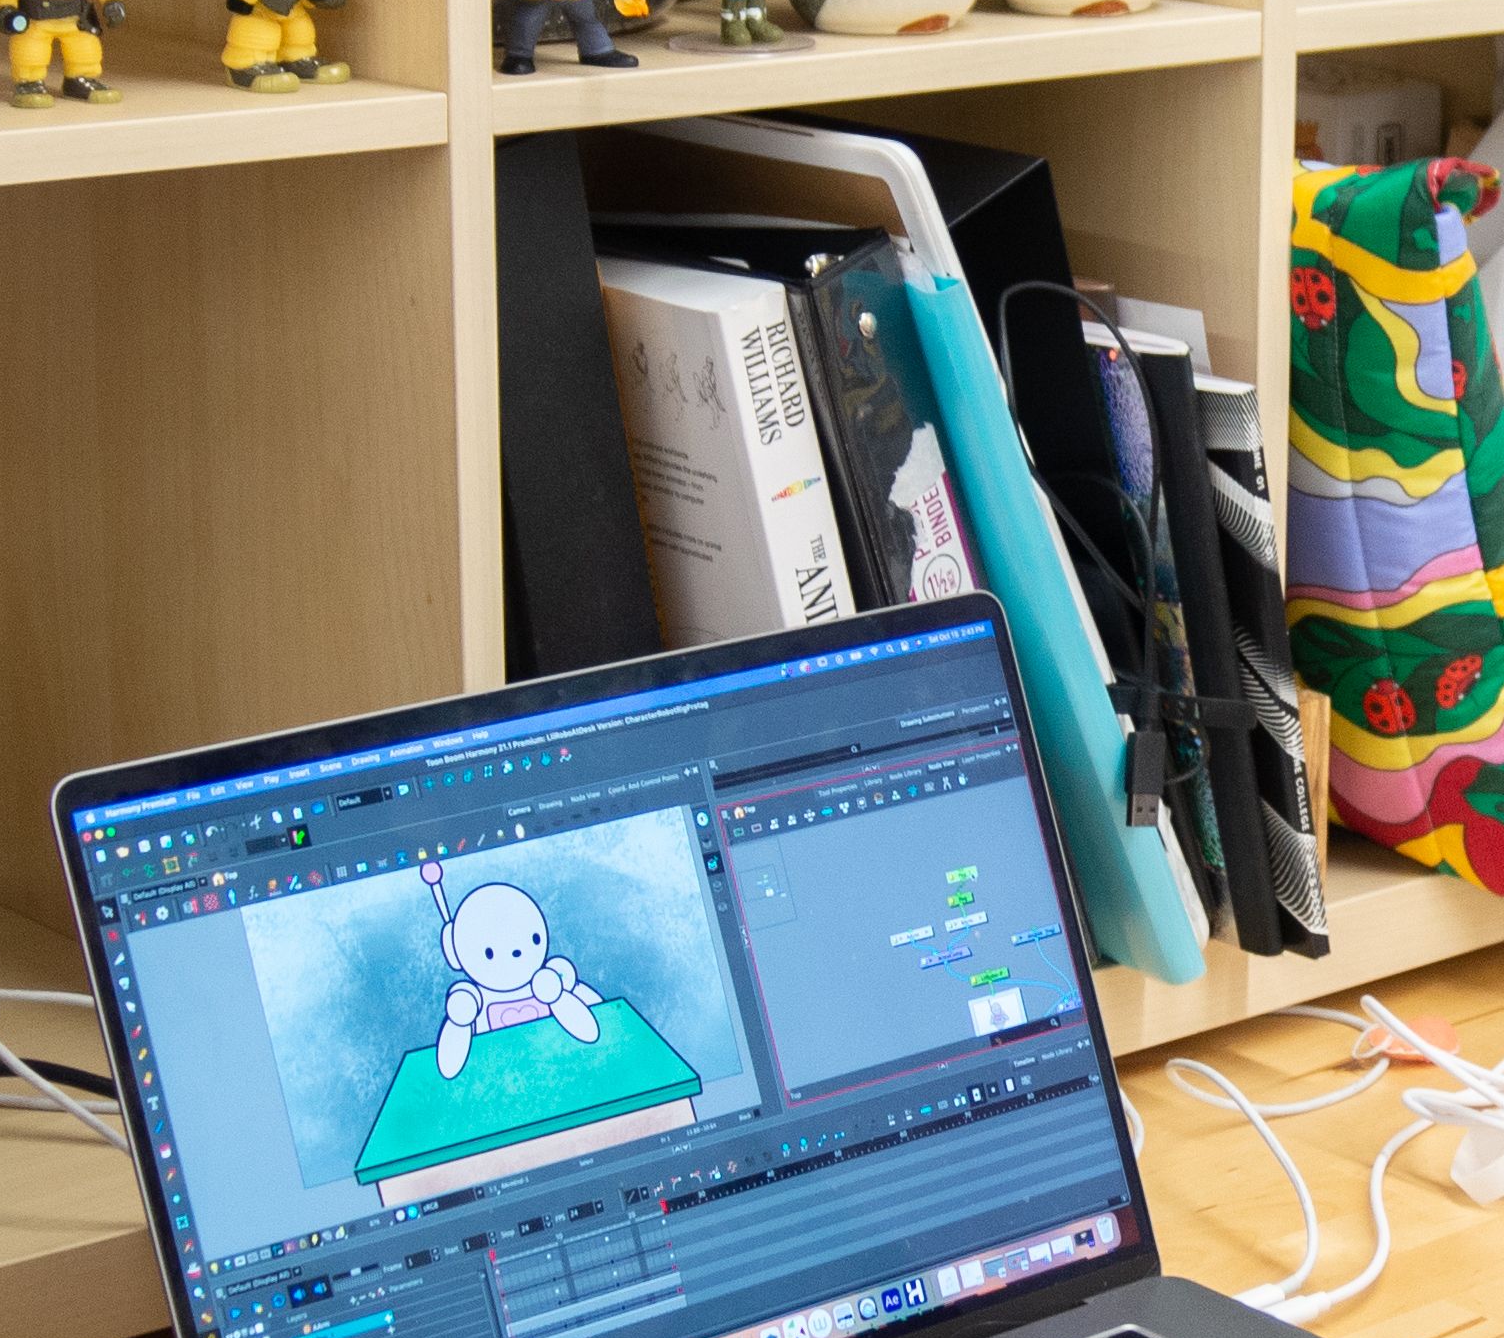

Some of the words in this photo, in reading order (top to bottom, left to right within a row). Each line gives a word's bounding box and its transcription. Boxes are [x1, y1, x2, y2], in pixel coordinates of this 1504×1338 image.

[766, 319, 805, 429] RICHARD
[740, 324, 782, 447] WILLIAMS
[810, 534, 827, 563] THE
[939, 633, 951, 642] Oct
[975, 624, 986, 634] PM
[961, 703, 990, 716] Perspective
[425, 758, 443, 768] Toon
[444, 752, 464, 764] Boom
[464, 746, 497, 762] Harmony
[512, 735, 546, 750] Premium:
[596, 718, 625, 732] Version:
[928, 762, 942, 771] Node
[105, 800, 141, 820] Harmony
[142, 794, 177, 814] Premium
[186, 790, 201, 801] File
[210, 785, 226, 797] Edit
[235, 779, 254, 791] View
[263, 774, 280, 787] Play
[289, 766, 311, 779] Insert
[319, 760, 342, 773] Scene
[351, 753, 381, 768] Drawing
[389, 743, 424, 758] Animation
[432, 734, 464, 750] Windows
[472, 729, 489, 742] Help
[337, 794, 363, 809] Default
[570, 793, 586, 804] Node
[586, 789, 601, 800] View
[1295, 769, 1311, 832] COLLEGE
[507, 804, 532, 817] Camera
[538, 798, 564, 811] Drawing
[223, 870, 238, 881] Top
[884, 1295, 900, 1308] Ae
